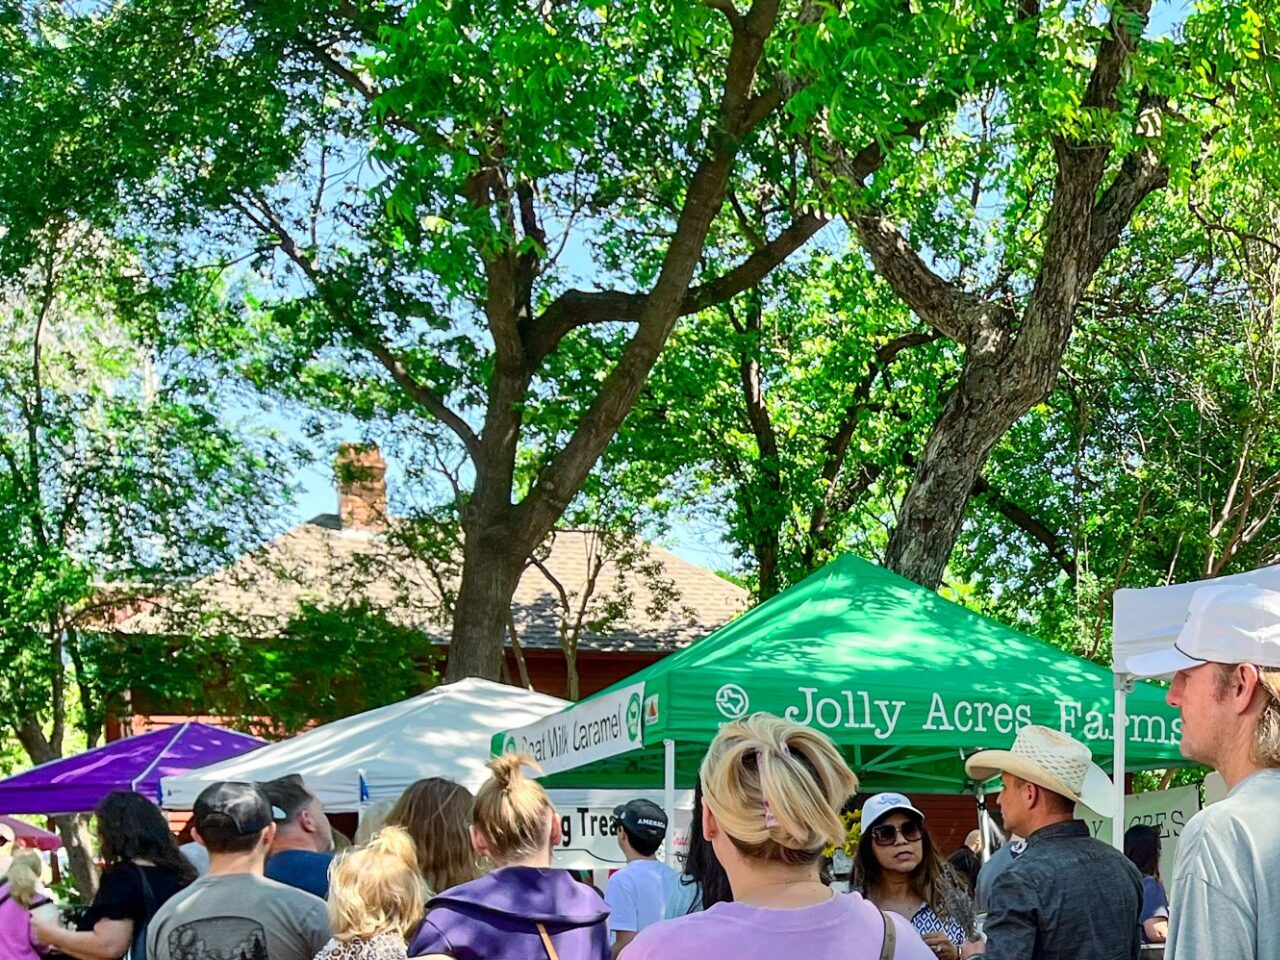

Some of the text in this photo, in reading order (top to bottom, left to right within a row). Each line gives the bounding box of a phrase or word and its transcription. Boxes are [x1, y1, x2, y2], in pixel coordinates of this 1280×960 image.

[573, 704, 622, 751] Caramel
[784, 687, 905, 739] Jolly
[922, 693, 1031, 732] Acres
[577, 808, 619, 837] Trea
